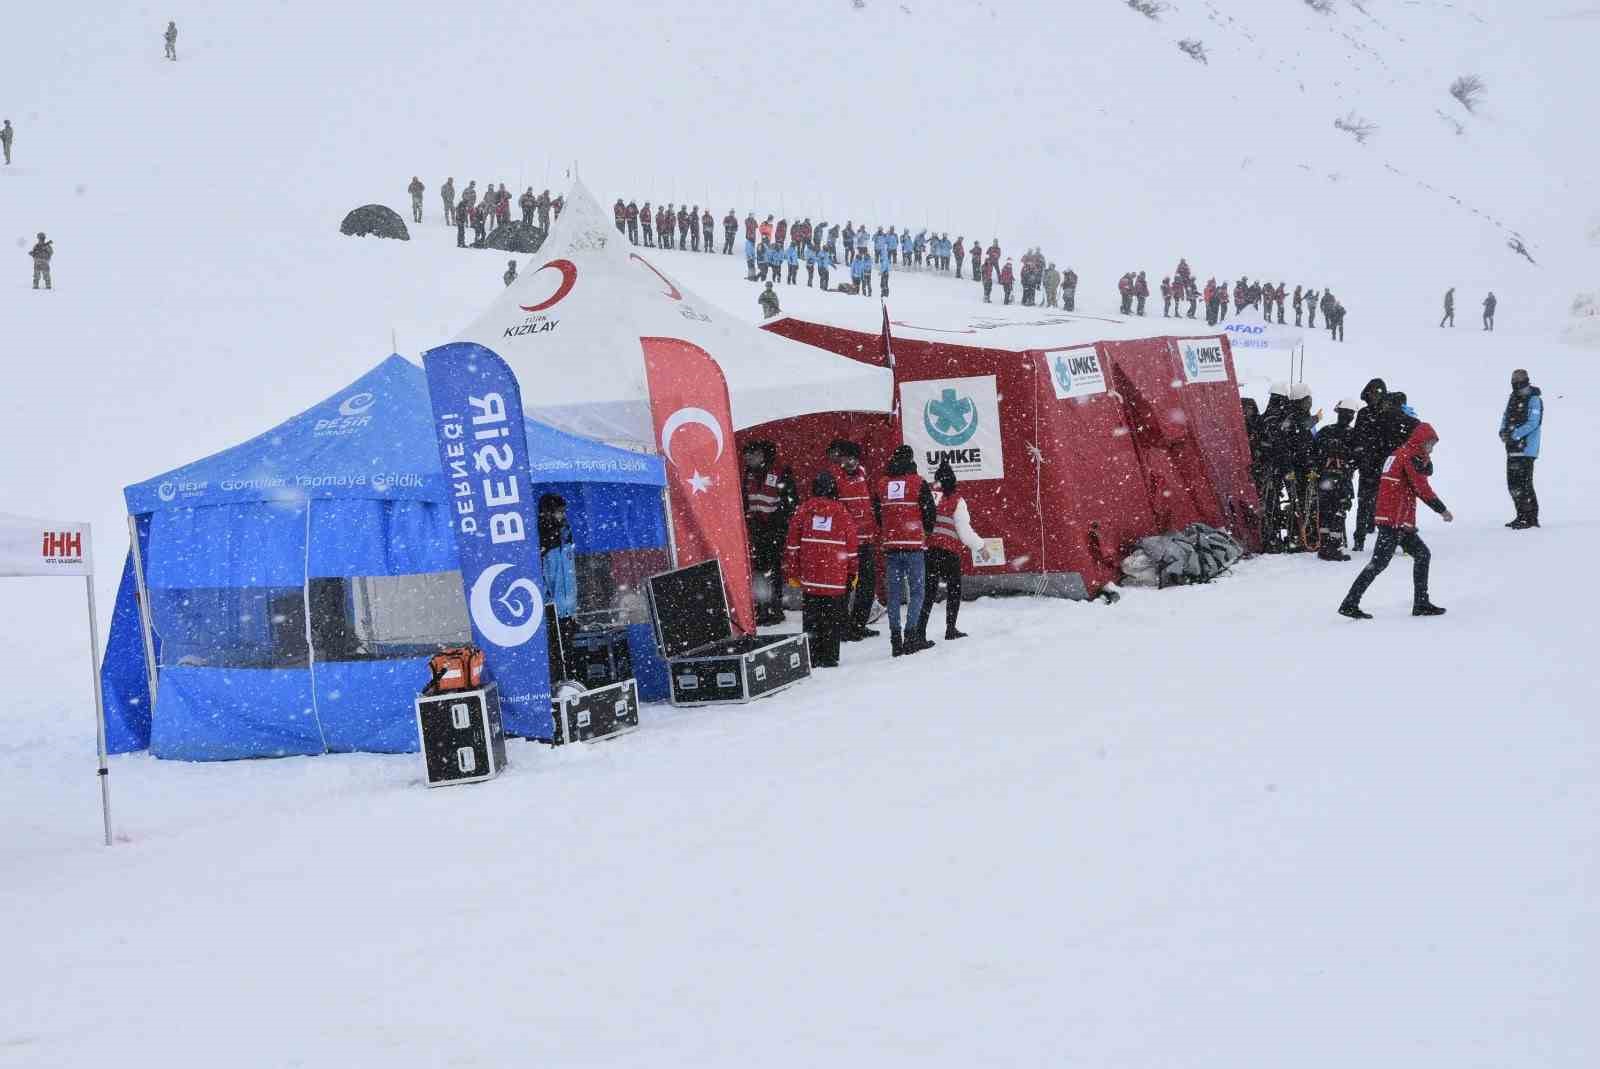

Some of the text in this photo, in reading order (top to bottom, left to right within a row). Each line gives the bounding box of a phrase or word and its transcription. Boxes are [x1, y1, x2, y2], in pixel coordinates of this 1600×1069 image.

[503, 320, 560, 337] KIZILAY
[1224, 324, 1264, 334] AFAD
[1196, 346, 1222, 363] UMKE
[1067, 355, 1098, 375] UMKE
[926, 448, 982, 465] UMKE
[295, 474, 367, 488] Yapmaya
[371, 471, 424, 488] Geldik
